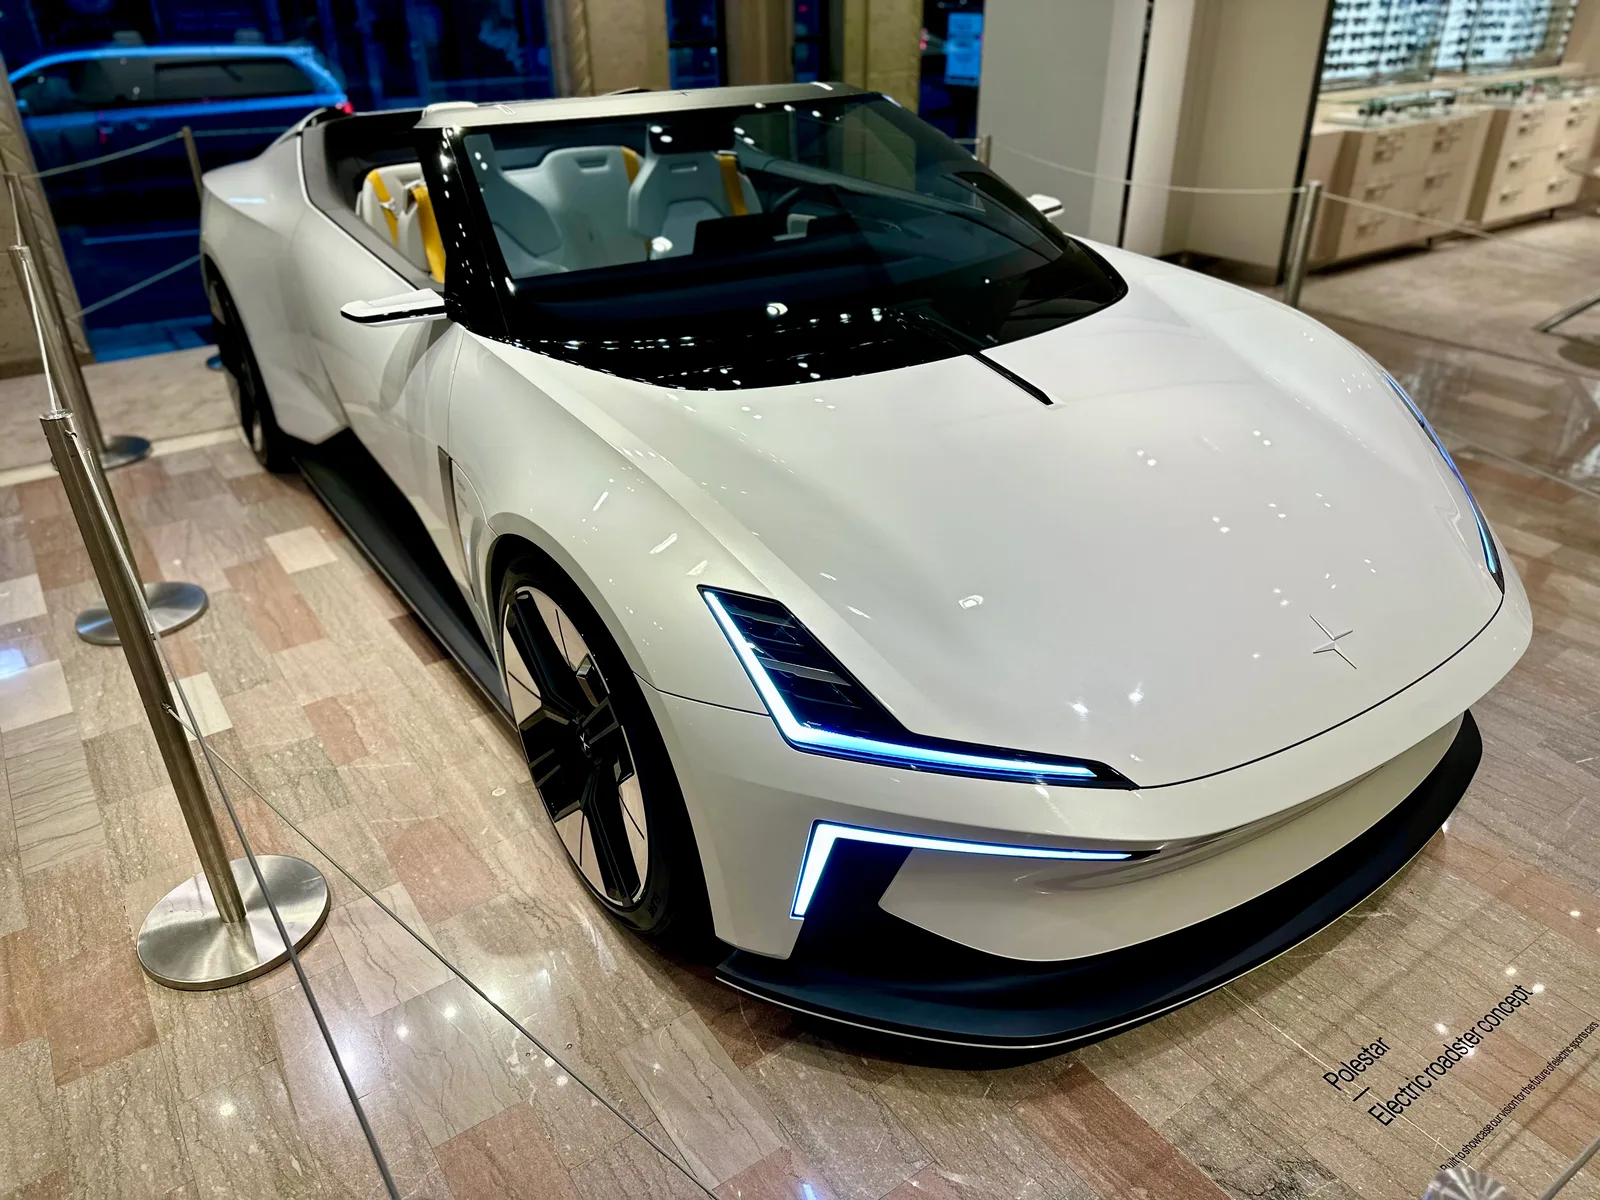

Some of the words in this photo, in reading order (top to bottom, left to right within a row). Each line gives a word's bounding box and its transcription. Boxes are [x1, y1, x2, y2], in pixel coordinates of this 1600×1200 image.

[1584, 1021, 1600, 1035] cars
[1568, 1031, 1589, 1049] sports
[1322, 1036, 1391, 1091] Polestar
[1367, 1075, 1432, 1126] Electric
[1423, 1026, 1484, 1081] roadster
[1477, 984, 1534, 1033] concept
[1551, 1046, 1574, 1067] electric
[1546, 1061, 1557, 1072] of
[1528, 1068, 1551, 1087] future
[1512, 1091, 1526, 1103] for
[1521, 1083, 1536, 1095] the
[1499, 1099, 1520, 1118] vision
[1490, 1114, 1503, 1127] our
[1462, 1124, 1495, 1155] showcase
[1454, 1151, 1466, 1161] to
